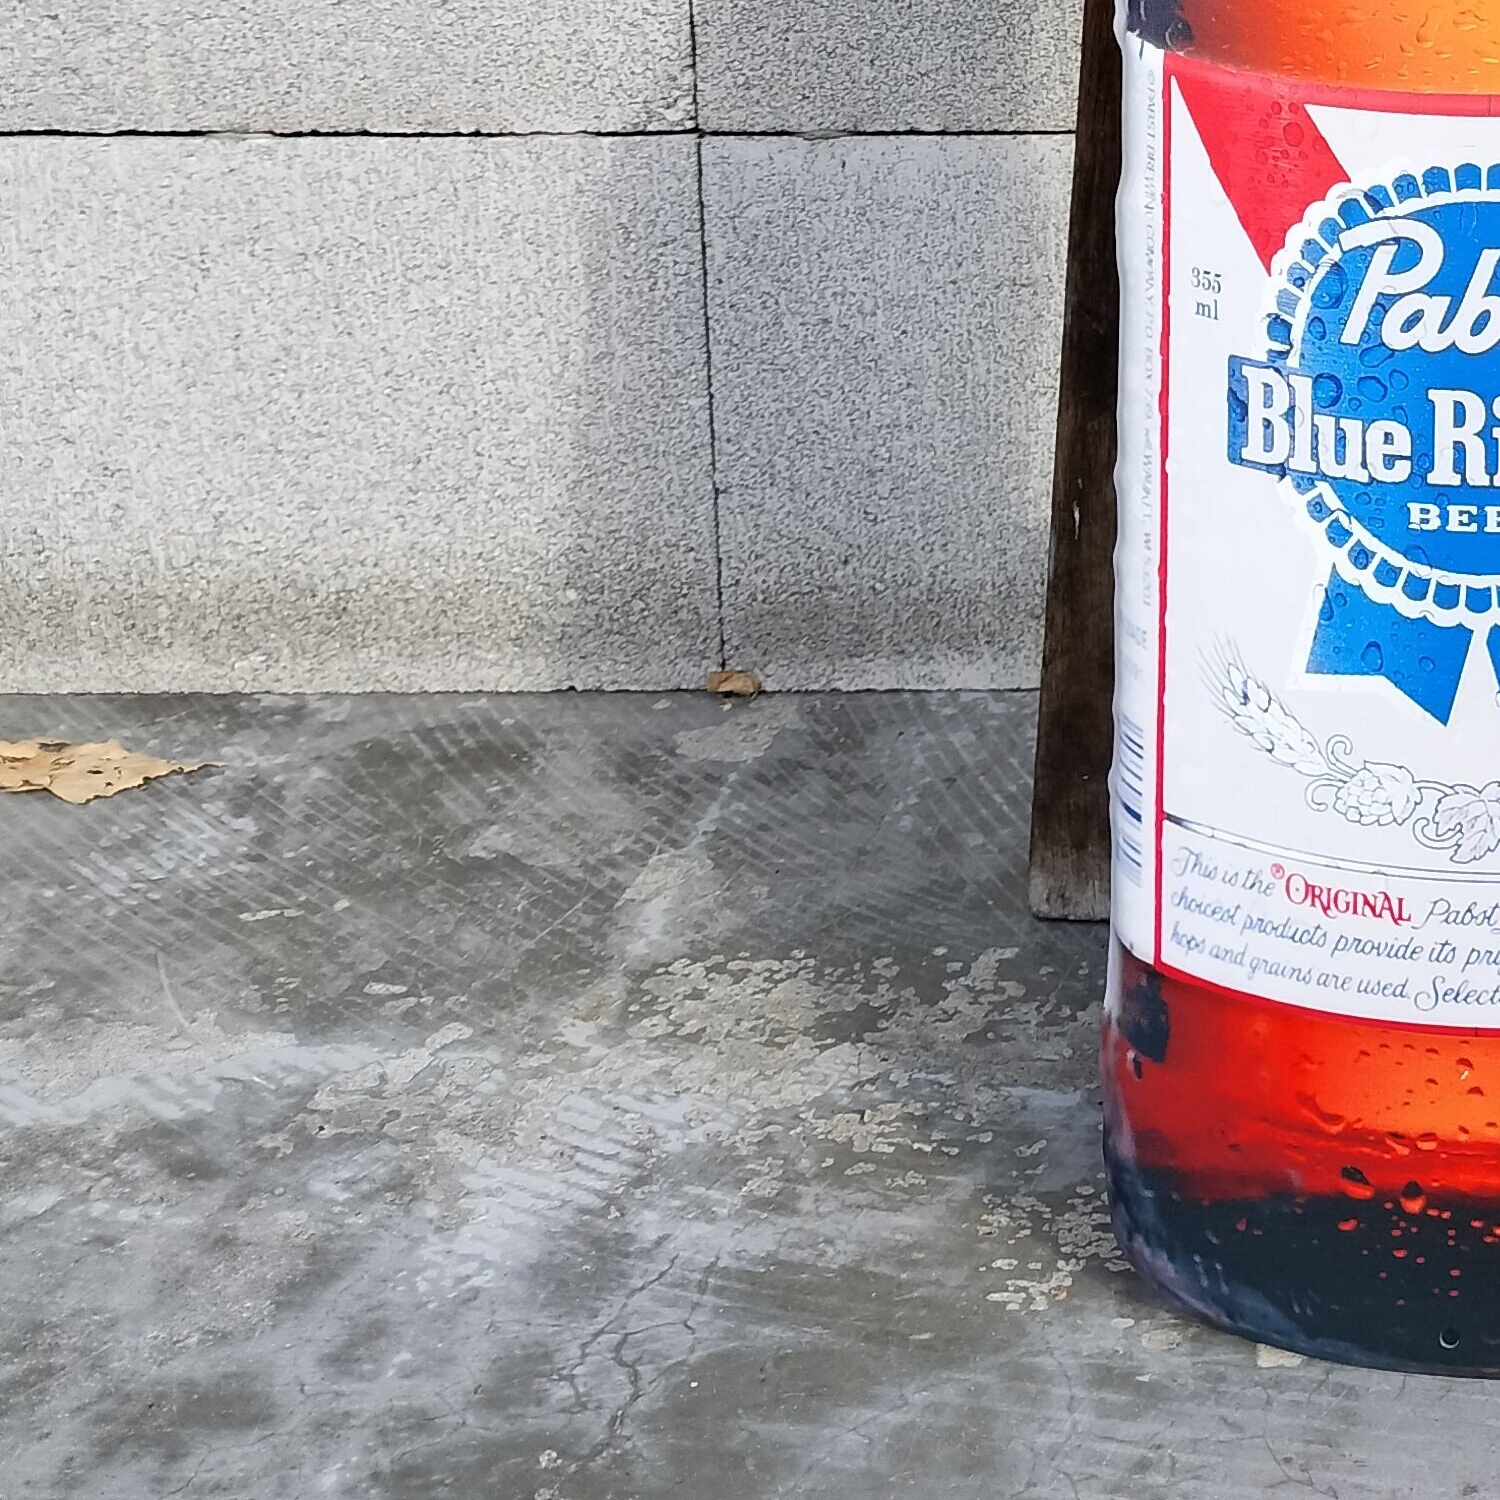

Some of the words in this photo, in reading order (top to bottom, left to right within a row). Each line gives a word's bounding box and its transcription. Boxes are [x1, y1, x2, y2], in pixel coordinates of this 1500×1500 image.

[1190, 266, 1222, 294] 355
[1194, 299, 1219, 321] ml
[1240, 362, 1413, 485] Blue
[1171, 846, 1218, 880] This
[1220, 864, 1239, 885] is
[1240, 866, 1276, 898] the
[1284, 872, 1412, 926] ORIGINAL
[1411, 897, 1500, 930] Pabst
[1171, 886, 1239, 925] choicest
[1239, 911, 1328, 948] products
[1332, 927, 1424, 963] provide
[1428, 939, 1457, 964] its
[1171, 921, 1207, 955] hops
[1208, 939, 1246, 968] and
[1246, 955, 1312, 982] grains
[1315, 971, 1352, 992] are
